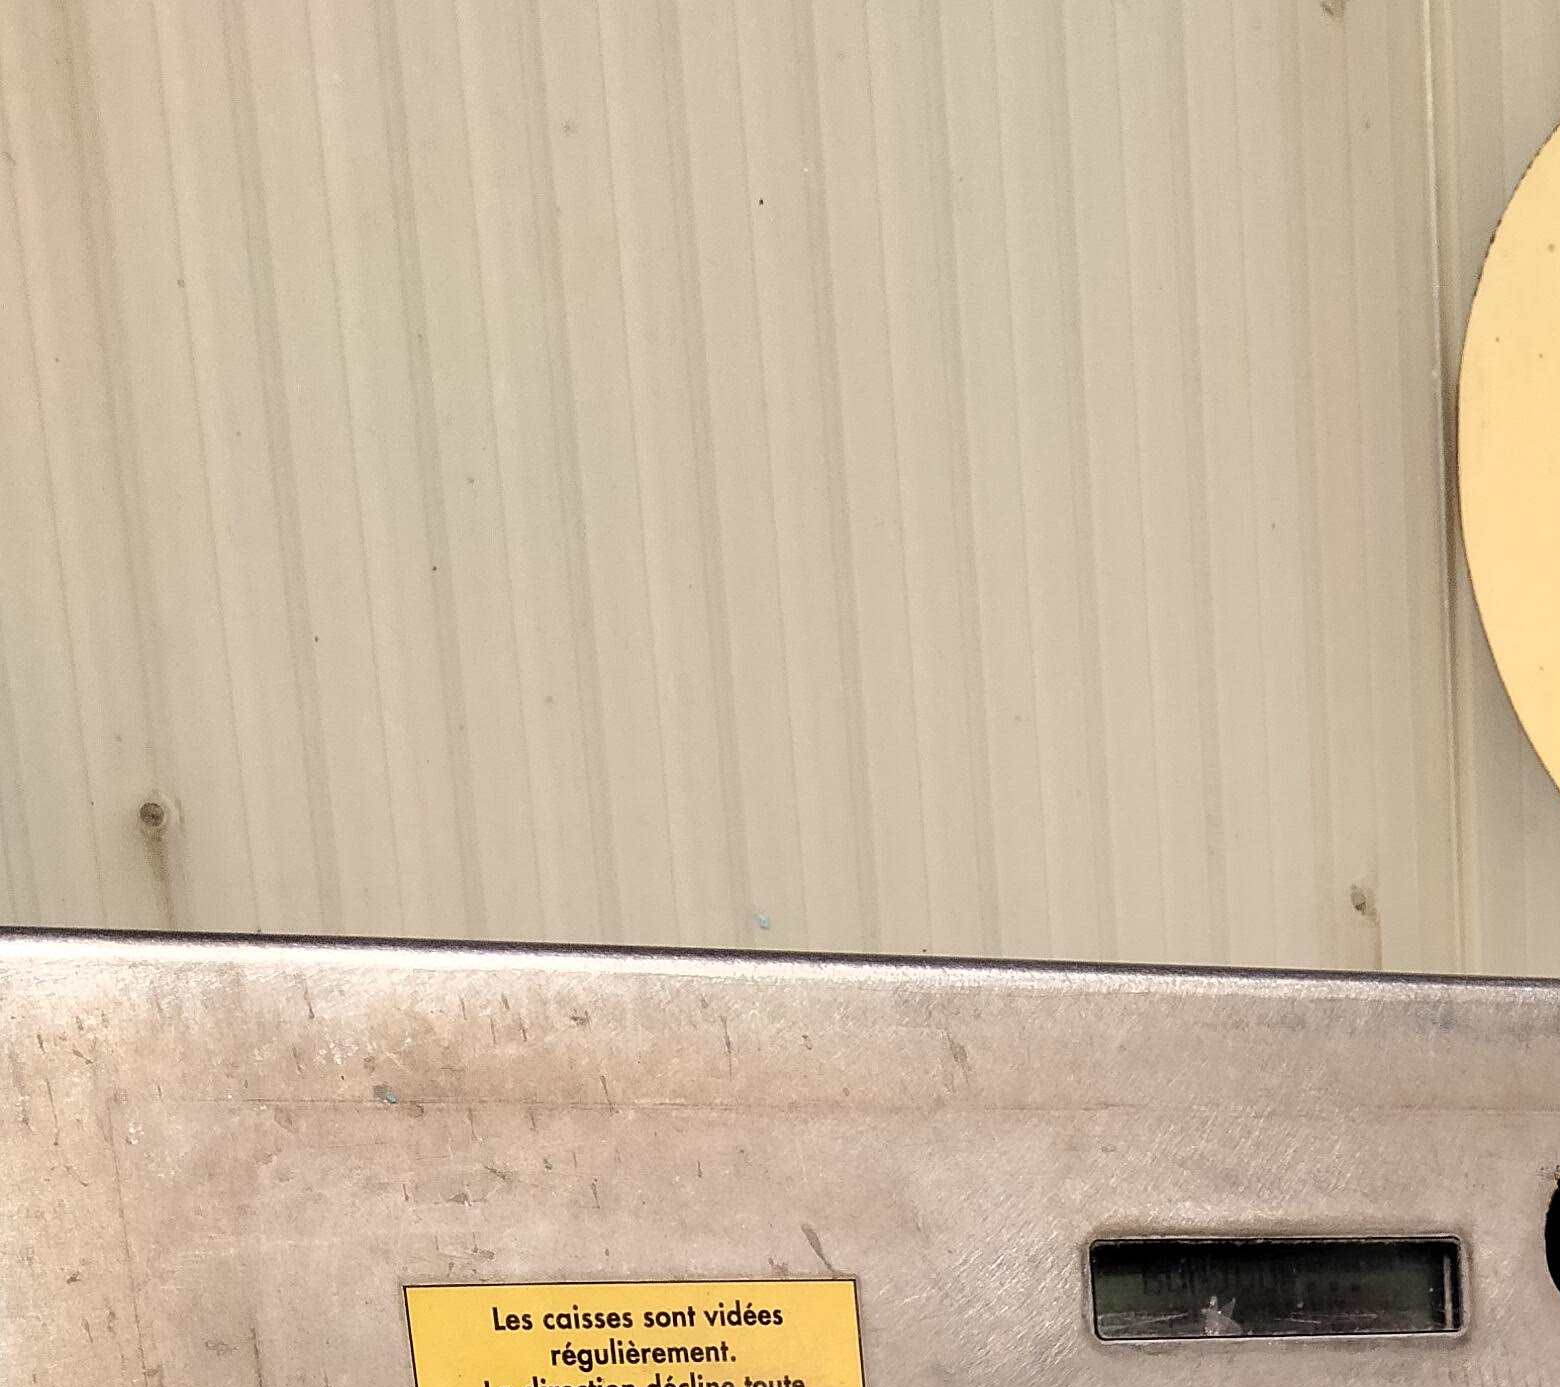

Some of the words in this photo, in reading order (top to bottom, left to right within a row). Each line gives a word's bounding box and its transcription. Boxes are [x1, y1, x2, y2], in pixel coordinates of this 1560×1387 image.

[493, 1307, 532, 1330] Les
[543, 1305, 633, 1329] caisses
[644, 1306, 695, 1327] sont
[704, 1300, 783, 1326] vidées
[551, 1338, 736, 1372] régulièrement.
